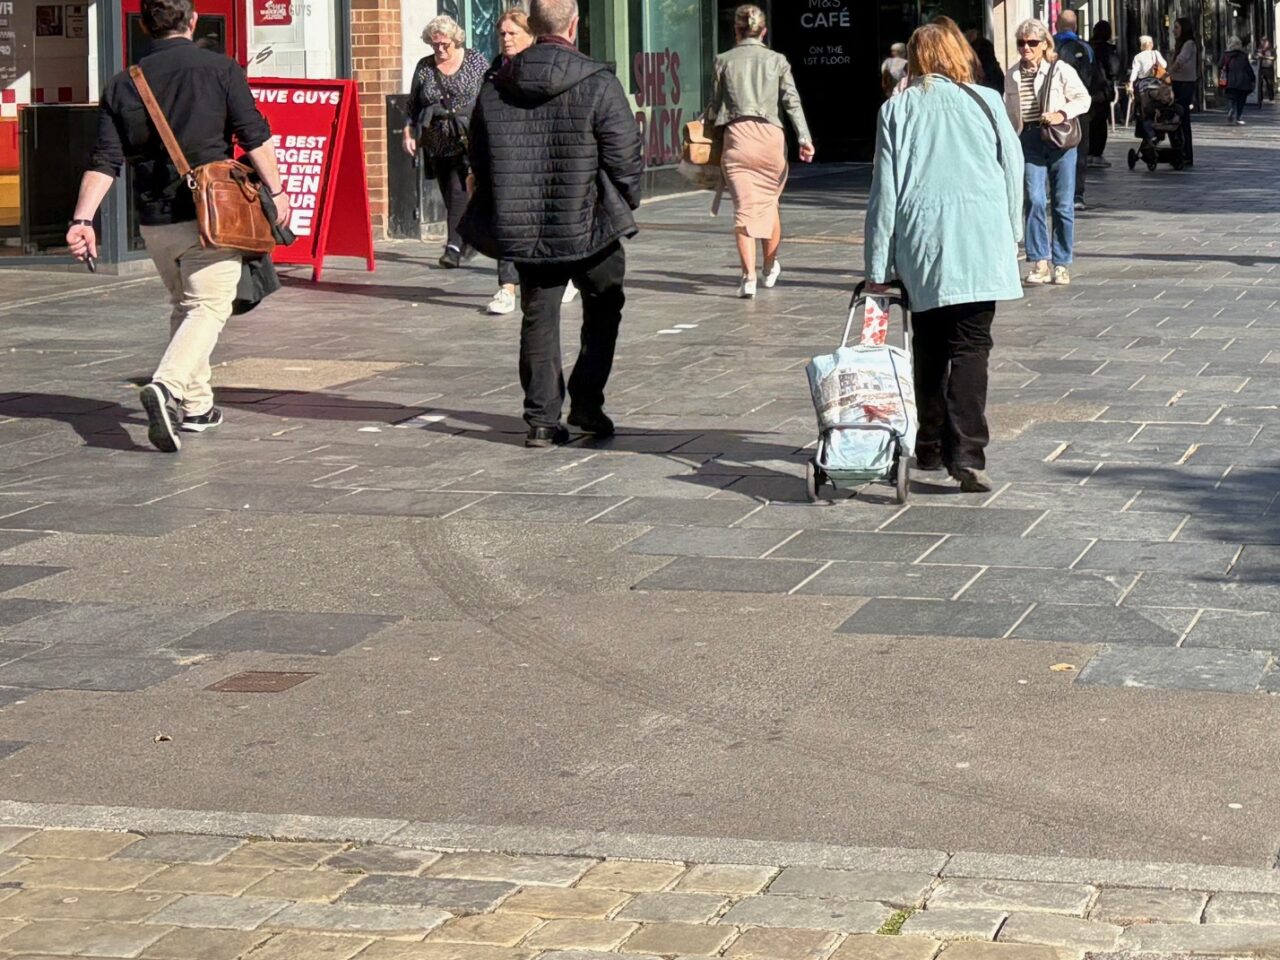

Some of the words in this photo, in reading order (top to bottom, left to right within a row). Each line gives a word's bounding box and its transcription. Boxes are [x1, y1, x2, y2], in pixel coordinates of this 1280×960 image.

[800, 6, 851, 28] CAFÉ
[809, 46, 823, 54] ON
[827, 45, 844, 54] THE
[820, 56, 851, 65] FLOOR
[634, 47, 681, 107] SHE'S
[250, 89, 288, 103] FIVE
[293, 91, 340, 104] GUYS
[285, 136, 327, 148] BEST
[275, 149, 323, 164] RGER
[290, 164, 321, 174] EVER
[280, 175, 320, 193] TEN
[289, 194, 316, 208] UR
